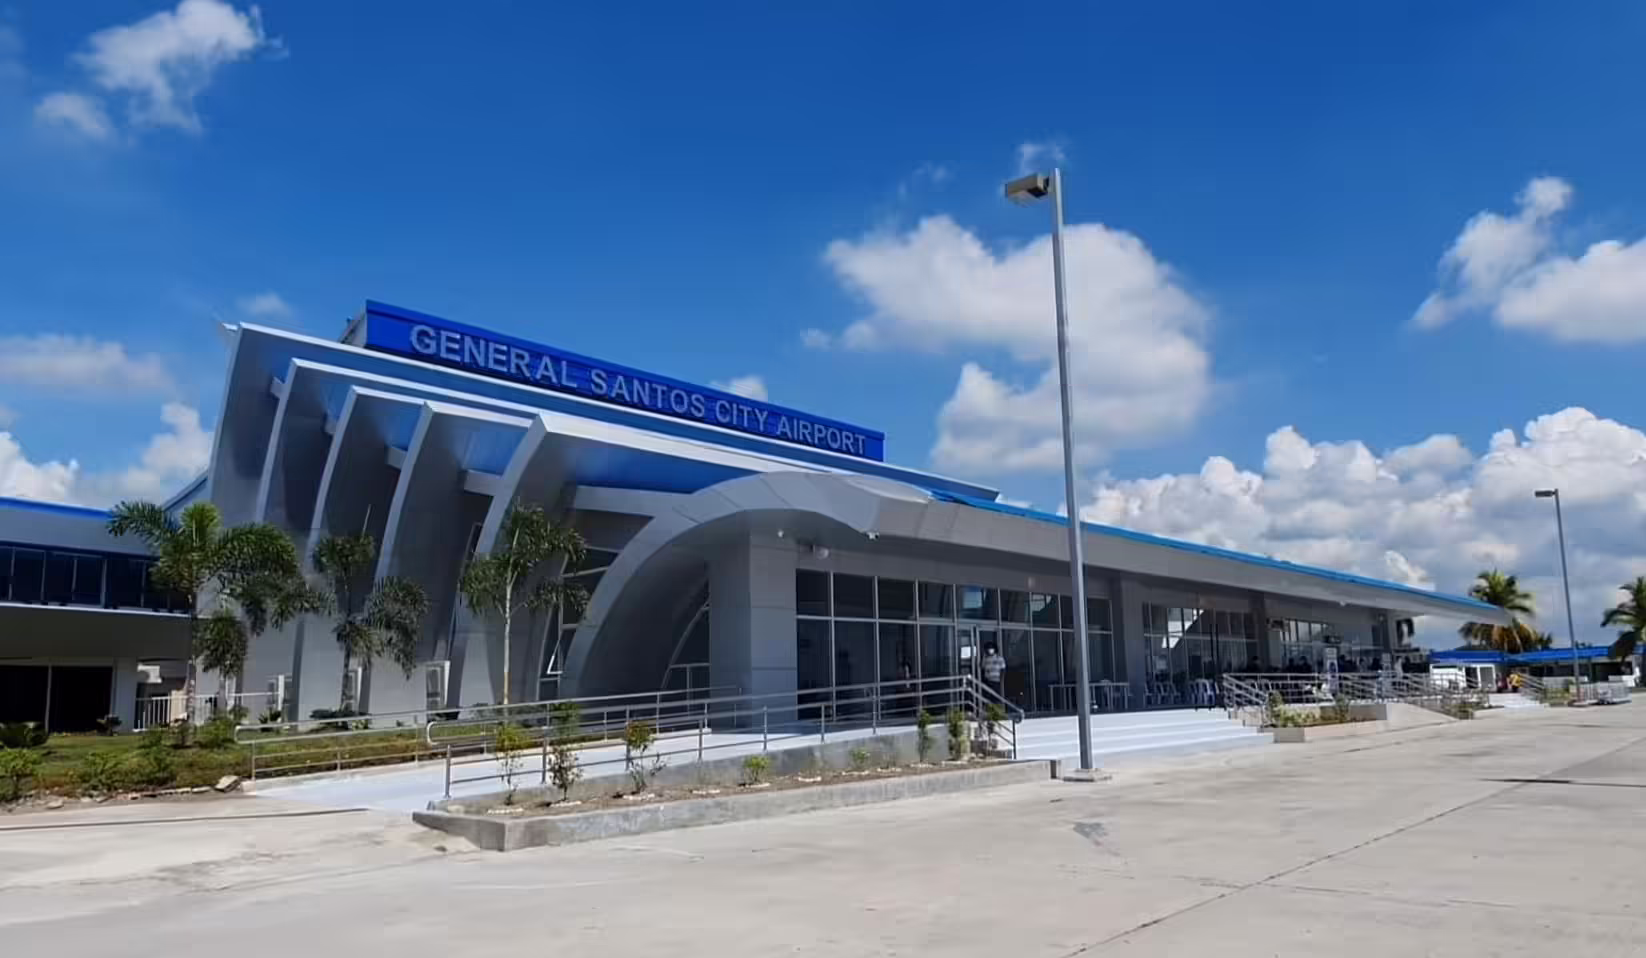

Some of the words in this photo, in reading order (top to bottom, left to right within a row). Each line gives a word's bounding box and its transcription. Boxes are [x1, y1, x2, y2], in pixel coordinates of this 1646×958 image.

[410, 325, 577, 388] GENERAL
[590, 368, 705, 418] SANTOS
[715, 400, 769, 432] CITY
[776, 416, 866, 455] AIRPORT
